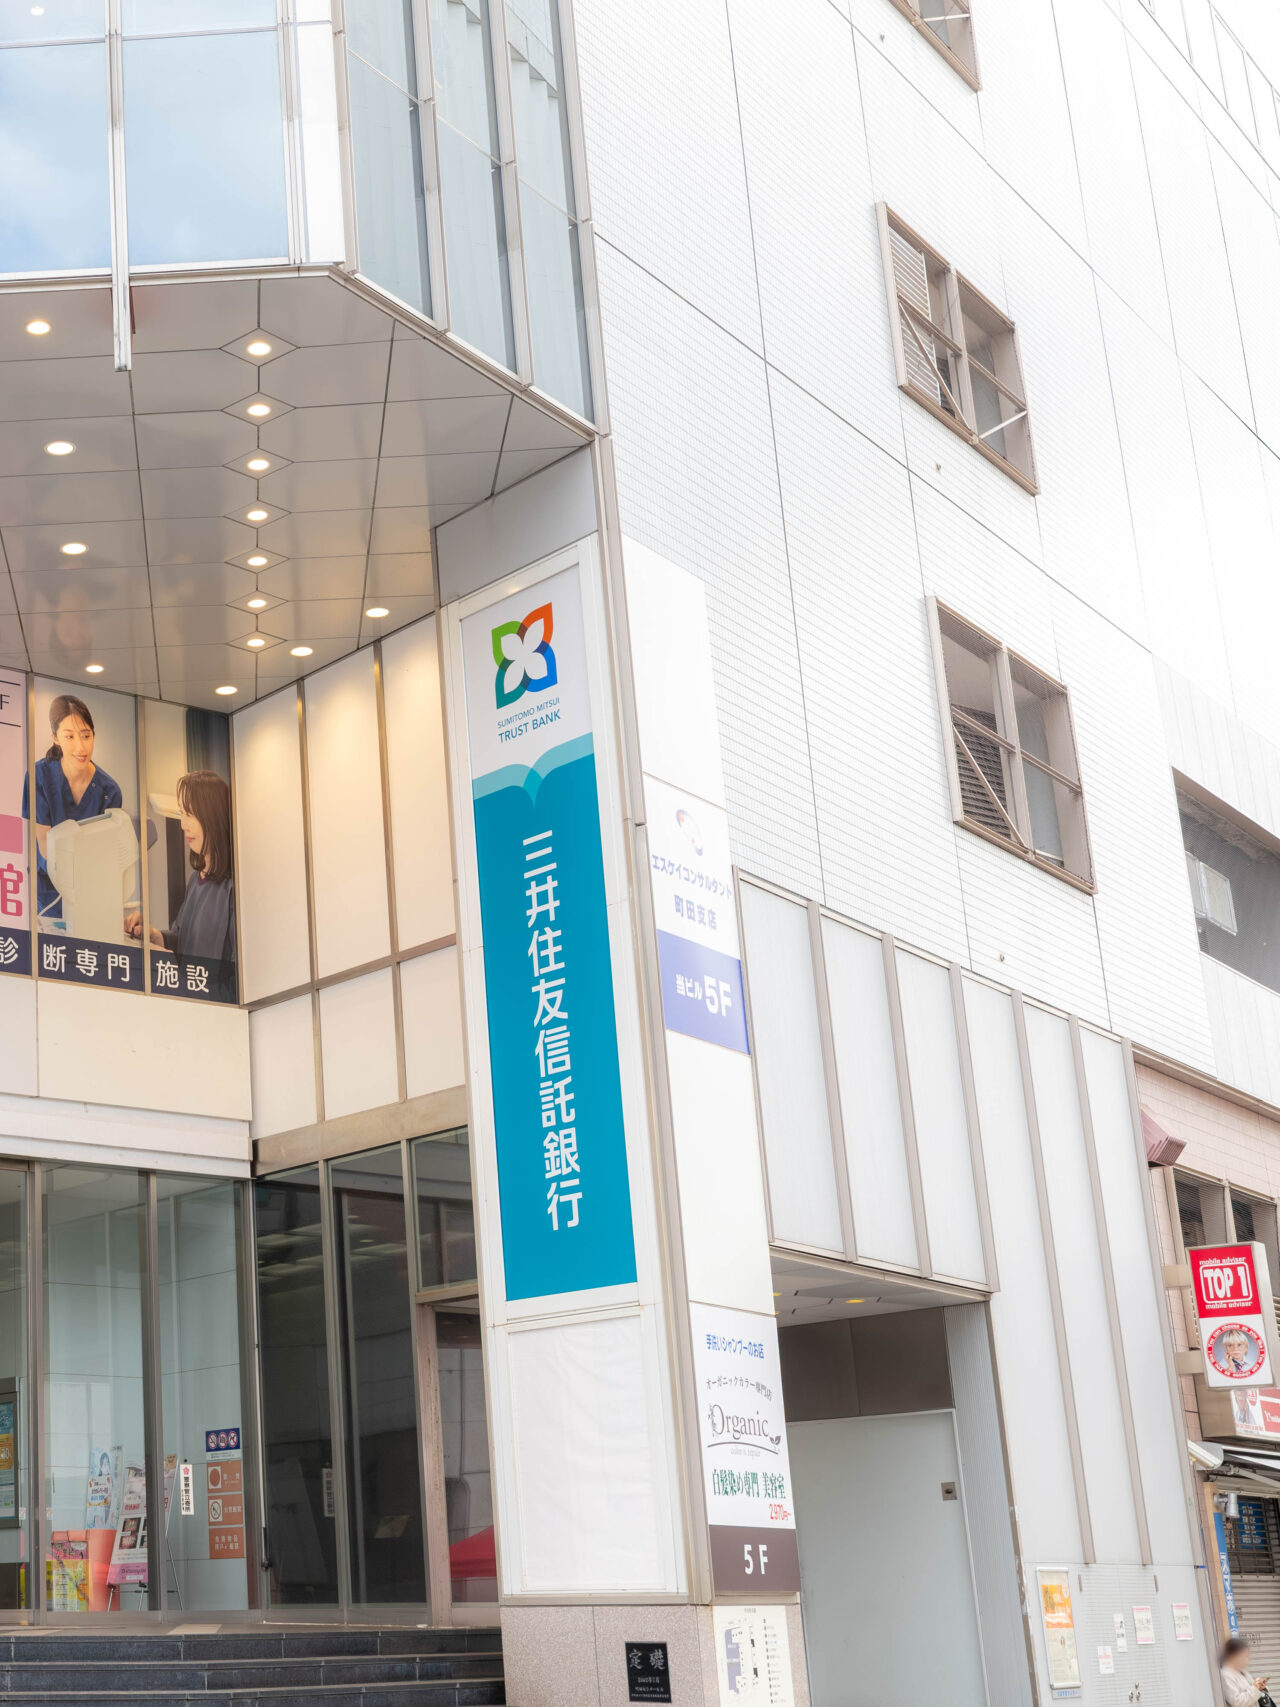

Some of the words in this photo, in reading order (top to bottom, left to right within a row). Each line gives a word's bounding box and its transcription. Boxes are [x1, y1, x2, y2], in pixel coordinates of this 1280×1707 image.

[497, 706, 535, 729] SUMITOMO
[536, 697, 560, 714] MITSUI
[498, 722, 529, 743] TRUST
[532, 709, 561, 730] BANK
[652, 854, 732, 900] エスケイコンサルタント
[674, 894, 717, 930] 町田支店
[675, 973, 702, 1000] 当ビル
[704, 974, 732, 1016] 5F
[522, 829, 583, 1231] 三井住友信託銀行
[1203, 1268, 1234, 1299] TOP
[1237, 1266, 1248, 1296] 1
[710, 1404, 769, 1440] Organic
[762, 1472, 786, 1499] 美容室
[744, 1544, 768, 1575] 5F
[629, 1648, 665, 1669] 定礎
